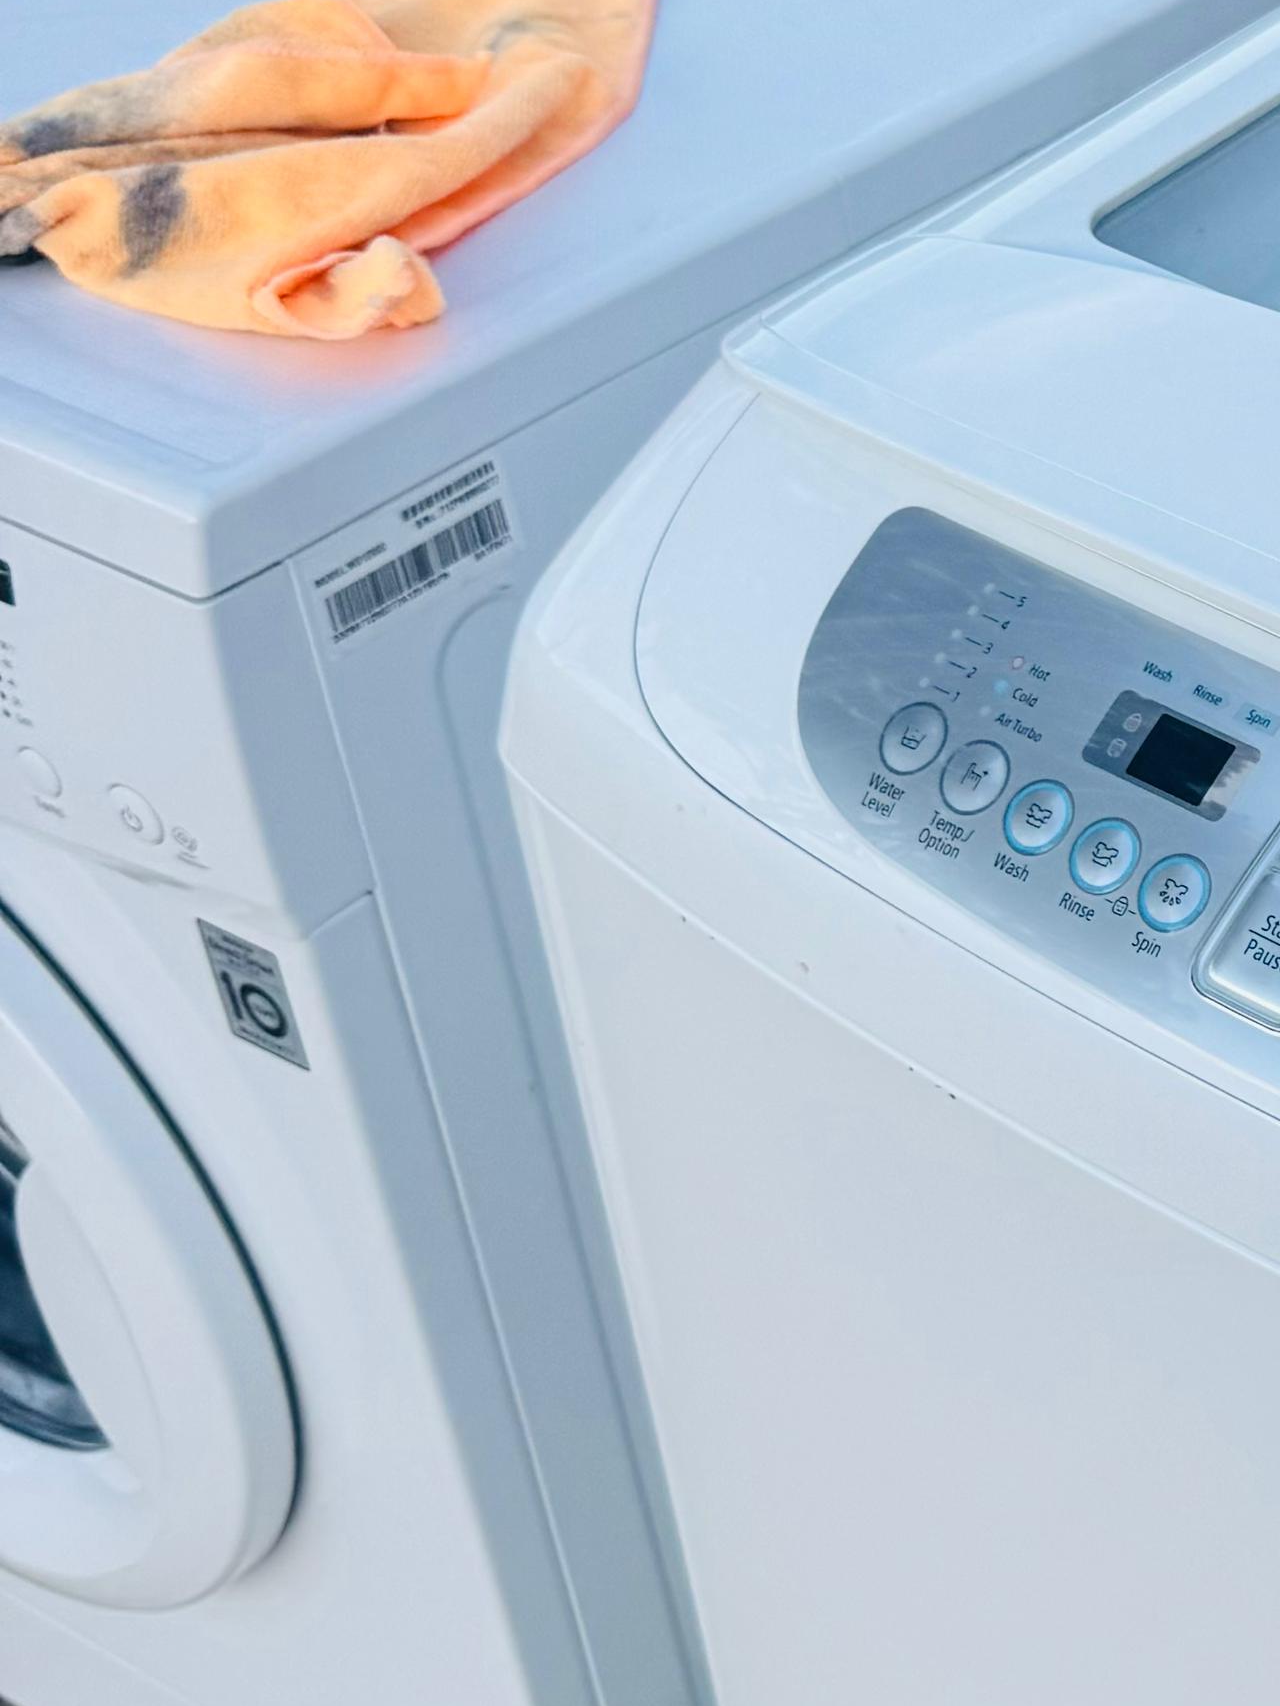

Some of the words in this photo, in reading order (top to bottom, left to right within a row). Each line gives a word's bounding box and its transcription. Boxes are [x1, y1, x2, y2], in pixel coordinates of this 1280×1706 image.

[1015, 594, 1028, 608] 5
[982, 642, 994, 655] 3
[966, 666, 978, 678] 2
[1029, 663, 1051, 682] Hot
[1142, 660, 1174, 683] Wash
[1012, 687, 1038, 708] Cold
[1192, 684, 1223, 706] Rinse
[995, 712, 1014, 729] Air
[1011, 720, 1043, 743] Turbo
[1245, 709, 1272, 730] Spin
[868, 772, 906, 802] Water
[861, 791, 895, 819] Level
[917, 827, 961, 860] Option
[993, 853, 1031, 882] Wash
[1058, 892, 1097, 922] Rinse
[1131, 930, 1163, 958] Spin
